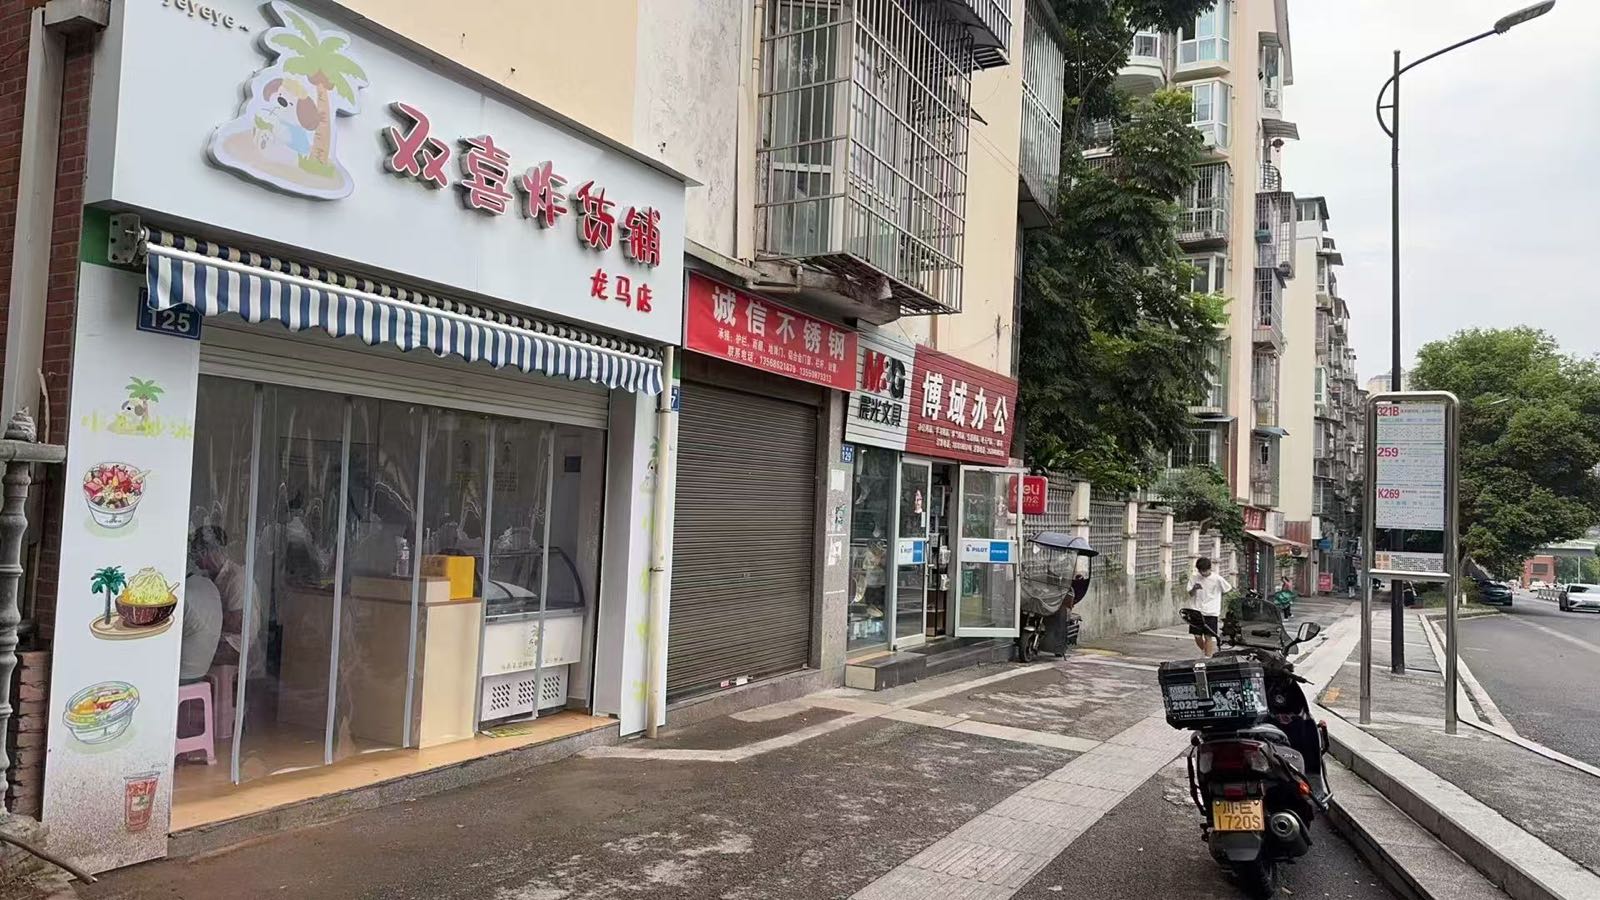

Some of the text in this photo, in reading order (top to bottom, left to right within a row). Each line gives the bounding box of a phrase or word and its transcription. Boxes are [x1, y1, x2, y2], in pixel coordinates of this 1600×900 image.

[385, 101, 660, 266] 双喜炸货铺
[590, 268, 652, 312] 龙马店
[147, 309, 191, 332] 125
[712, 285, 845, 361] 诚信不锈钢
[857, 394, 903, 428] 晨光文具
[922, 370, 1008, 435] 博域办公
[1377, 406, 1400, 417] 321B
[1377, 447, 1399, 457] 259
[1378, 488, 1400, 499] K269
[1172, 701, 1199, 710] 2025
